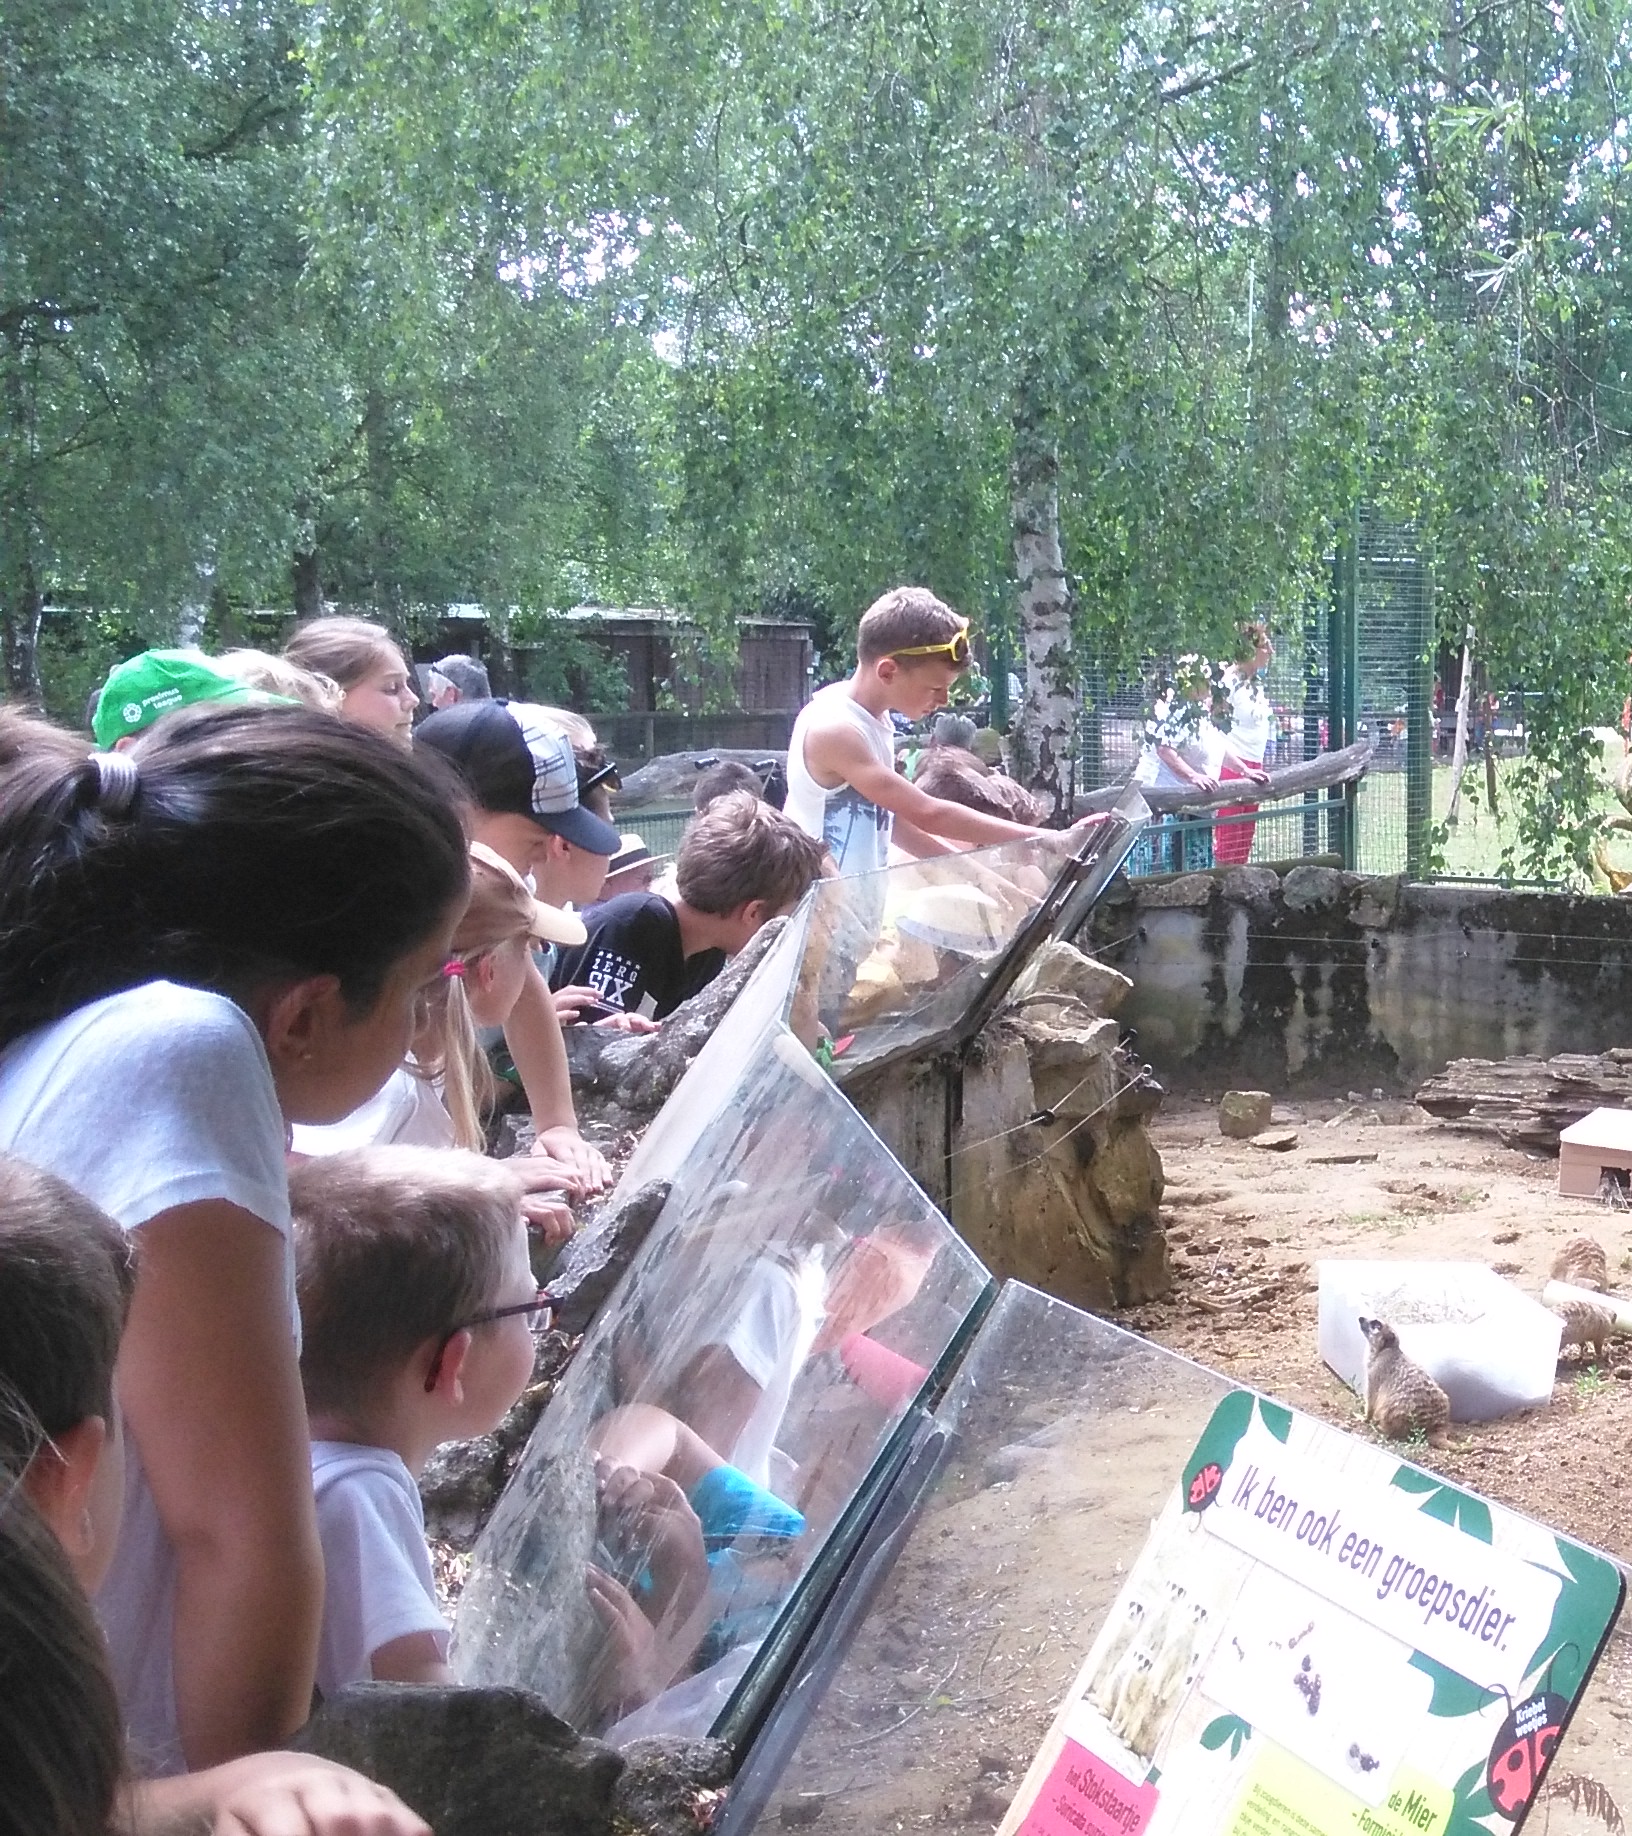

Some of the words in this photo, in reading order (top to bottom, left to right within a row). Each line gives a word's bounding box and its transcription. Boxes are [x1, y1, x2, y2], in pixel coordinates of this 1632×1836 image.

[589, 970, 634, 1007] SIX
[592, 957, 638, 983] ZERO
[1231, 1464, 1261, 1511] Ik
[1254, 1475, 1299, 1532] ben
[1296, 1509, 1342, 1556] ook
[1338, 1531, 1384, 1579] een
[1376, 1554, 1517, 1652] groepsdier.
[1078, 1768, 1141, 1835] Stokstaartje
[1387, 1790, 1403, 1812] de
[1401, 1789, 1439, 1832] Mier
